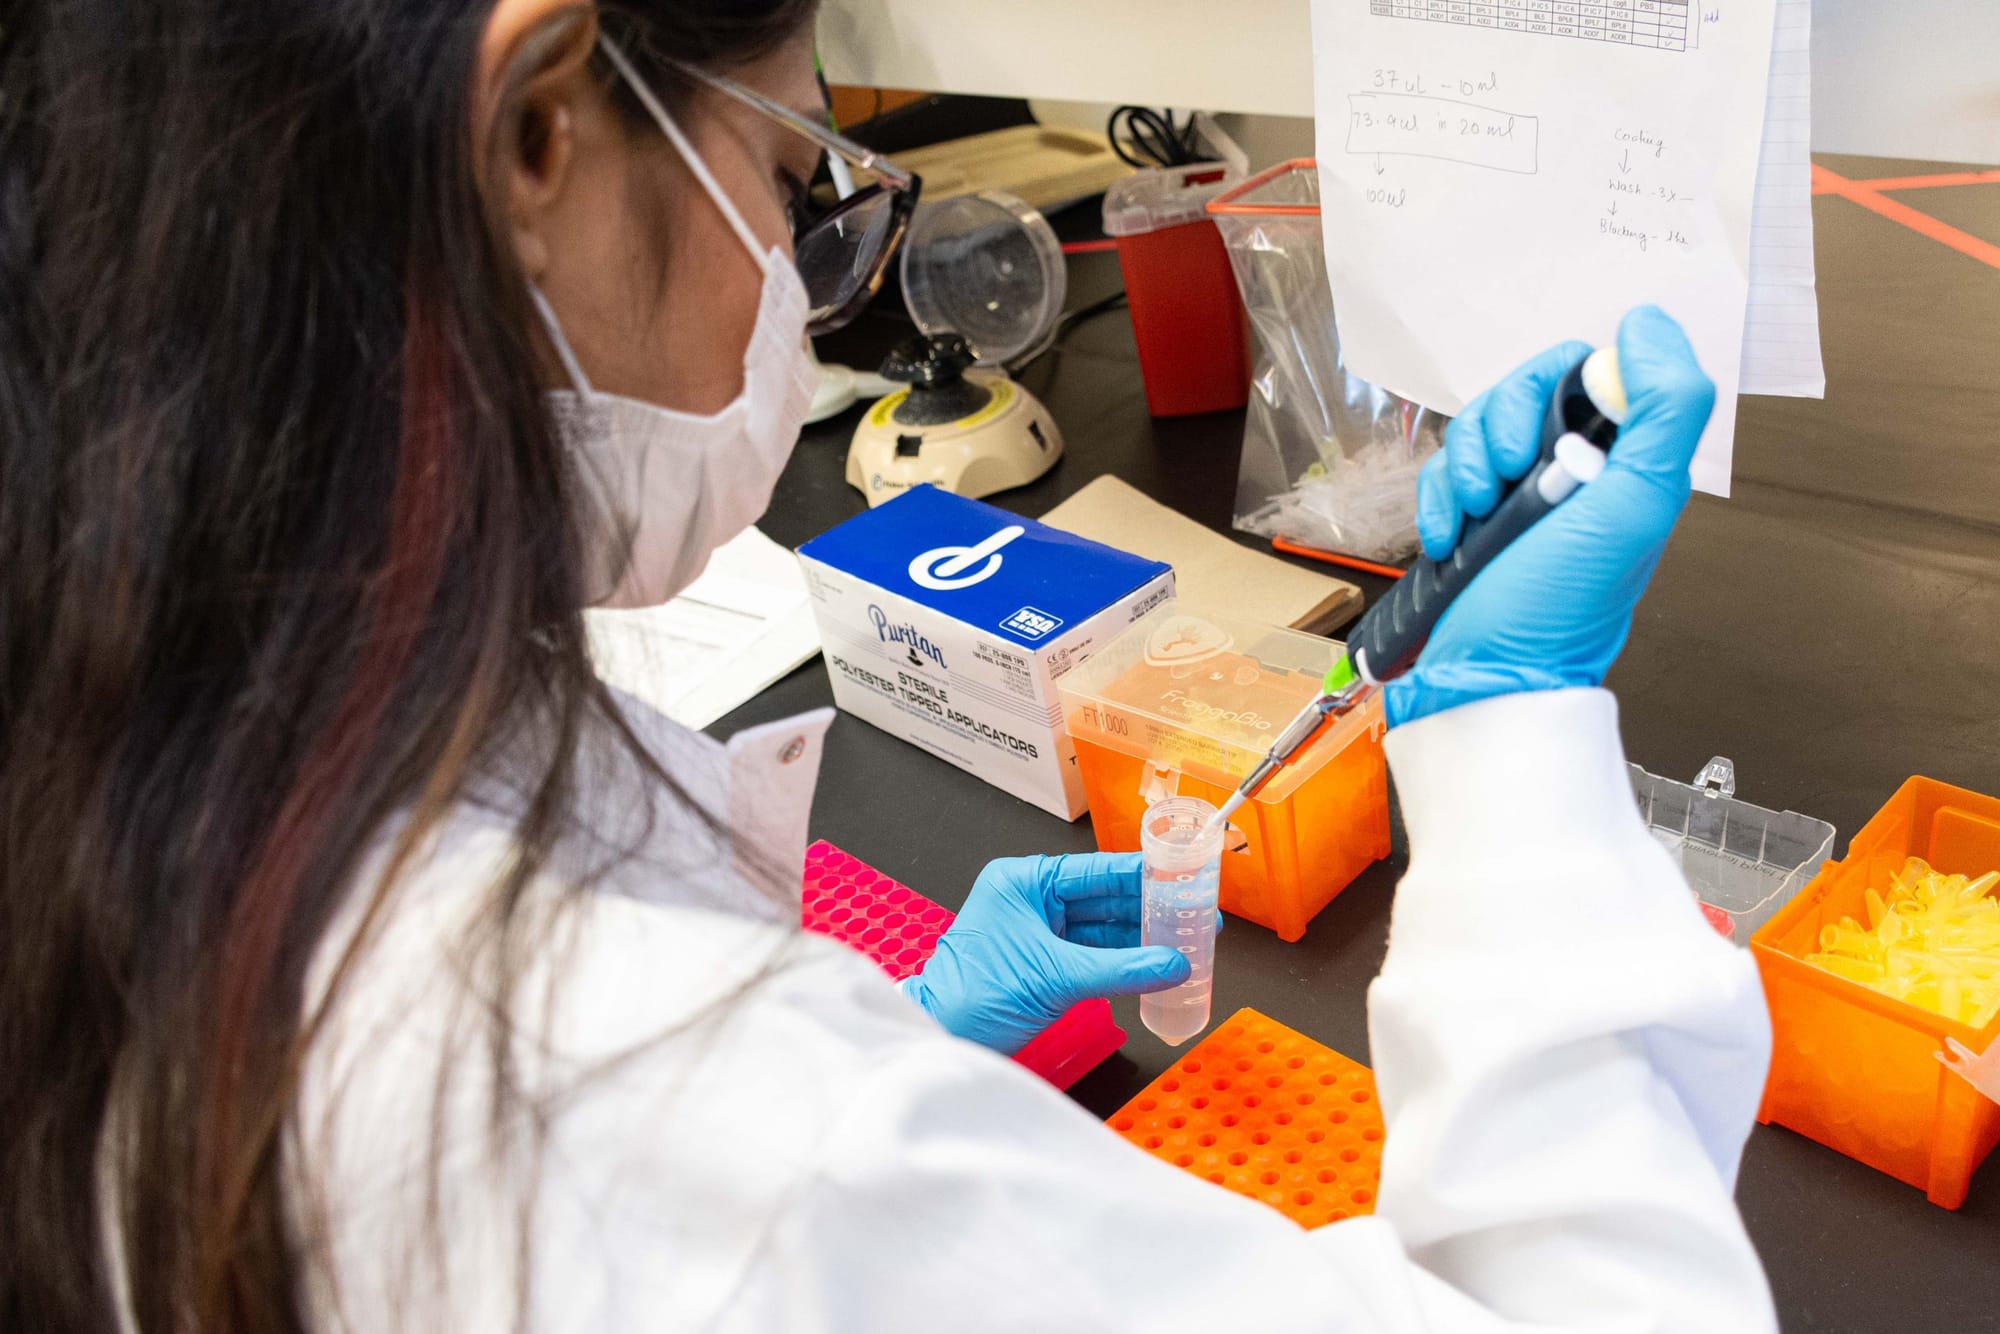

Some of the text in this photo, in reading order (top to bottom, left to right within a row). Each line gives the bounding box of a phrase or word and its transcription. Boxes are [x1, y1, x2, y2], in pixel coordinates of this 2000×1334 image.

[1460, 118, 1480, 136] 20
[868, 603, 948, 669] Puritan
[897, 671, 949, 704] STERILE
[832, 655, 897, 696] POLYESTER
[898, 686, 943, 716] TIPPED
[947, 708, 1039, 759] APPLICATORS
[1082, 706, 1129, 737] FT1000
